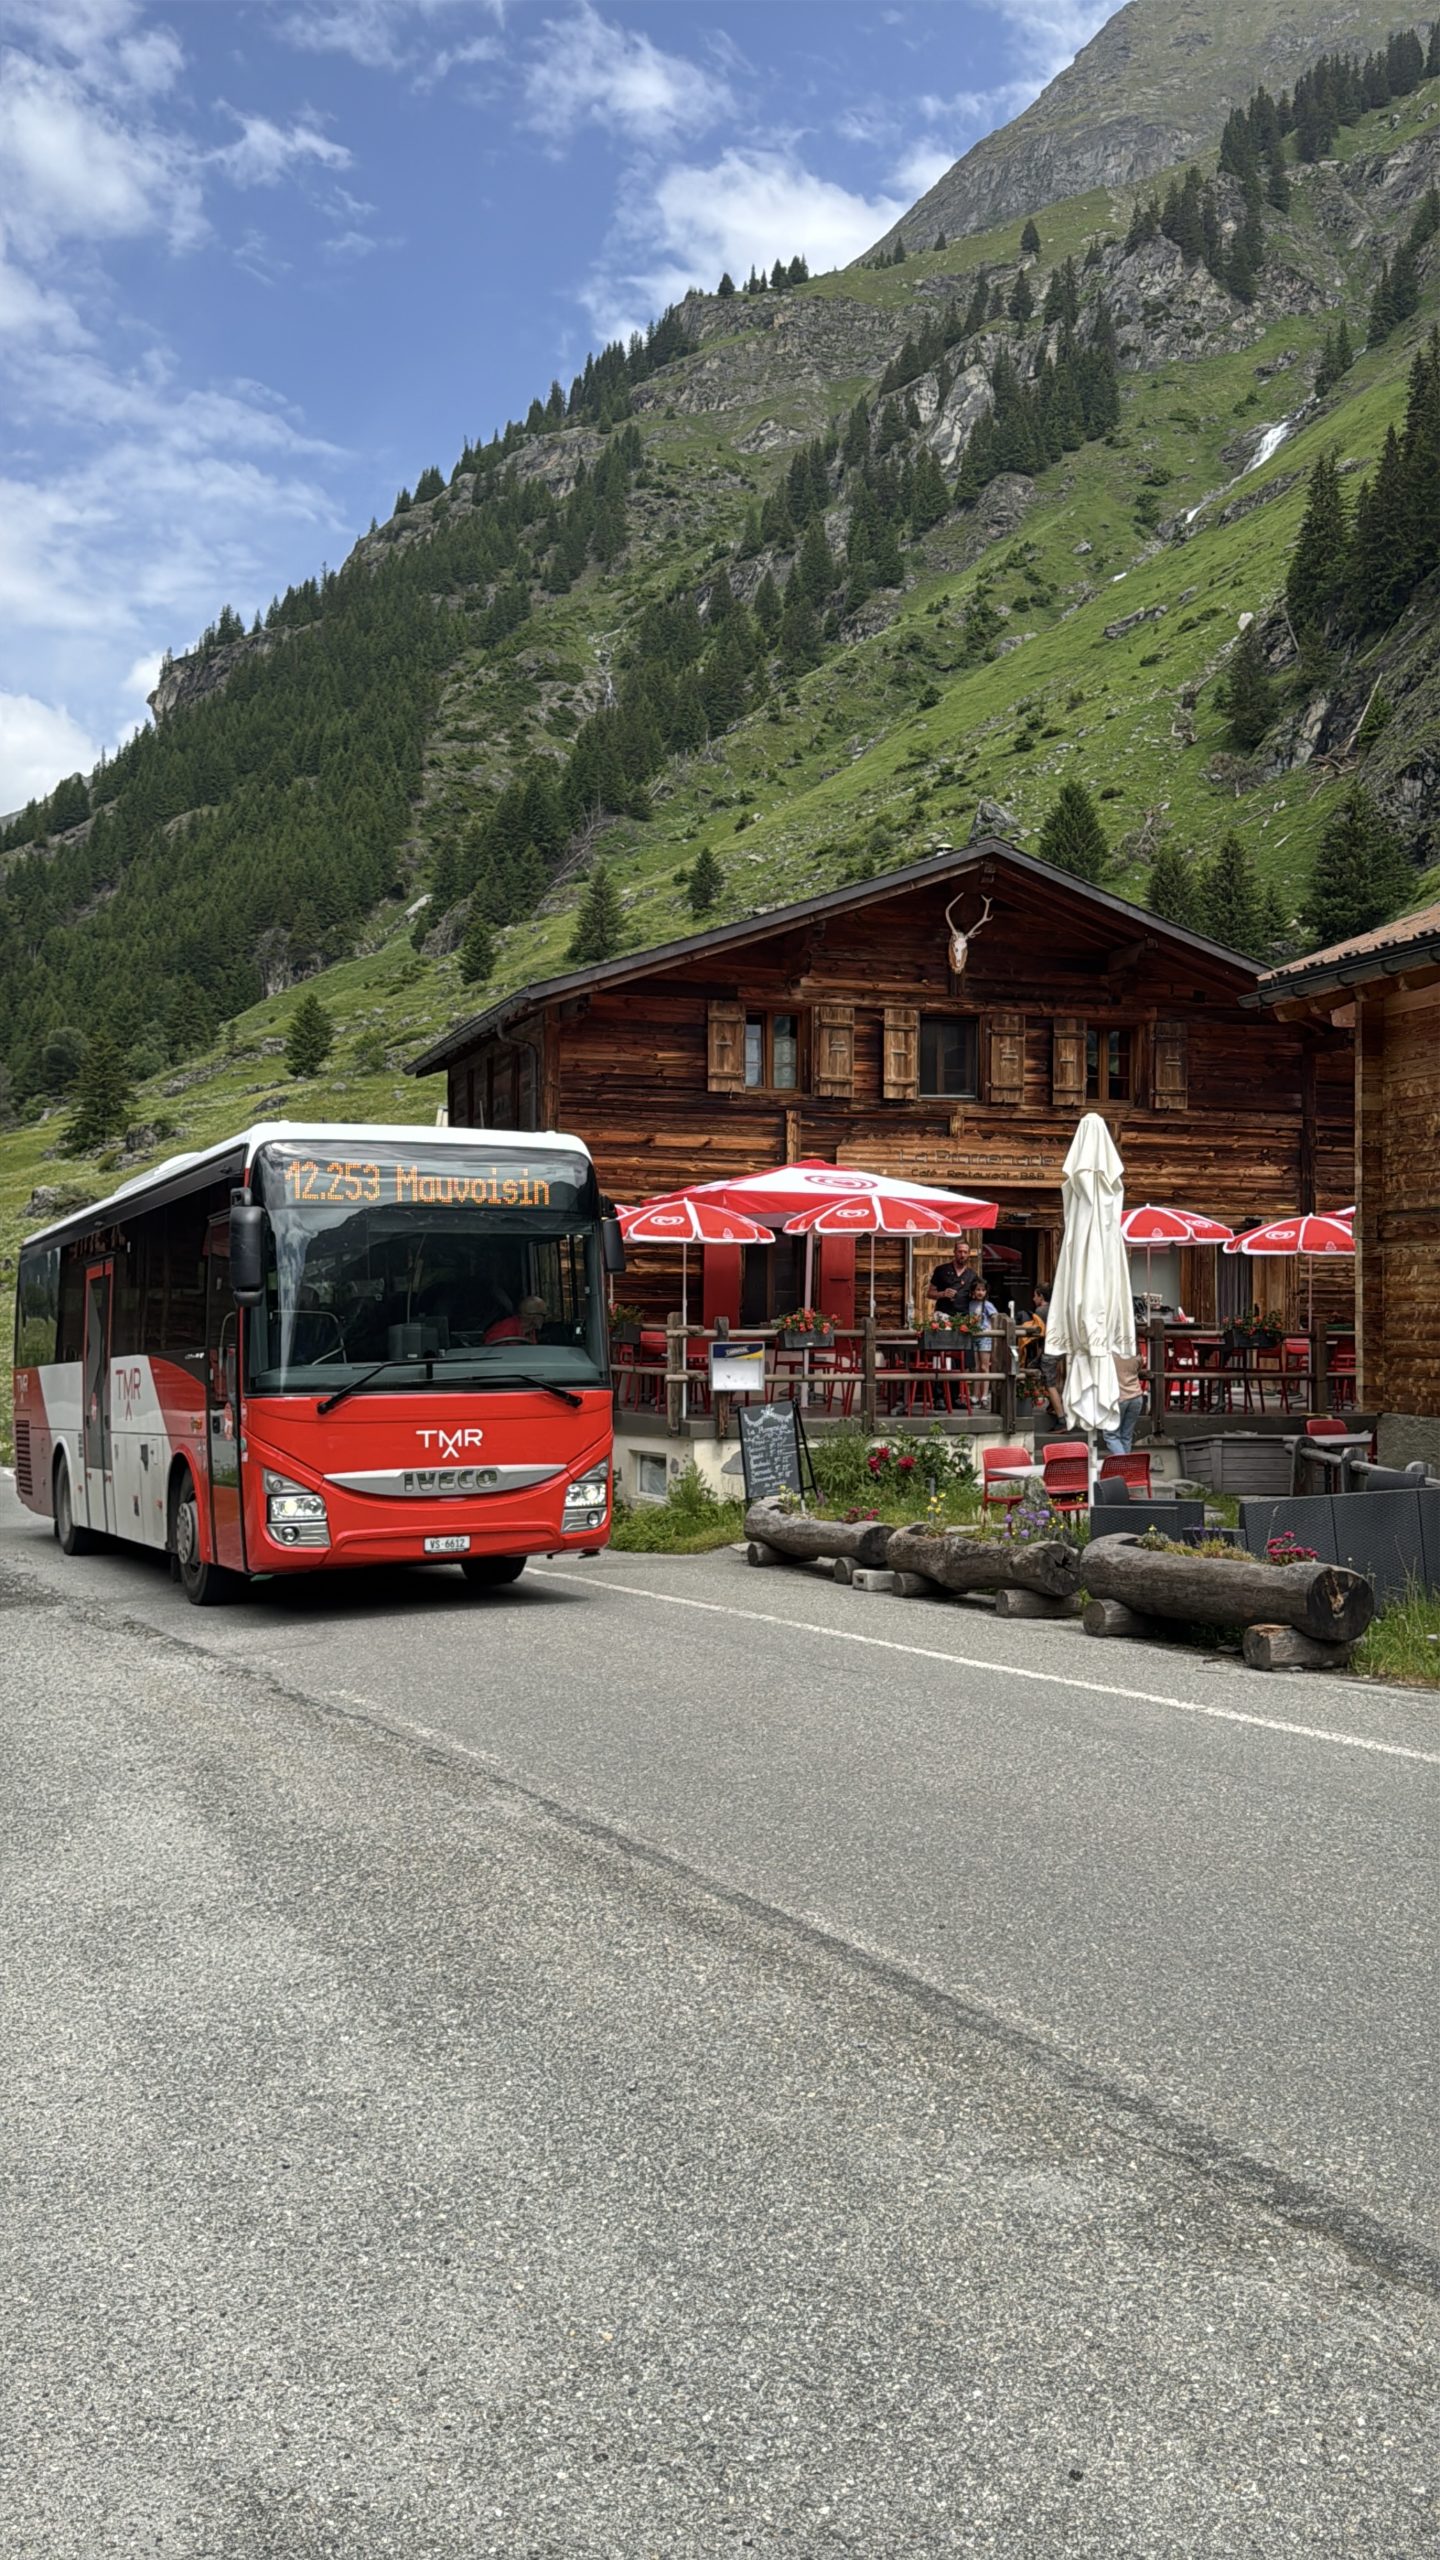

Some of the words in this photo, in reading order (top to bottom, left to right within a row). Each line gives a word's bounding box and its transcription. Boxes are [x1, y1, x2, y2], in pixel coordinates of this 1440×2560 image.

[899, 1149, 928, 1163] La
[935, 1150, 1056, 1166] Promenade
[284, 1160, 380, 1201] 12.253
[396, 1164, 550, 1205] Mauvoisin
[911, 1168, 938, 1178] Café
[947, 1170, 1010, 1180] Restaurant
[1020, 1171, 1045, 1180] B&B
[115, 1367, 142, 1421] TMR
[415, 1428, 484, 1458] TMR
[403, 1469, 498, 1491] IVECO
